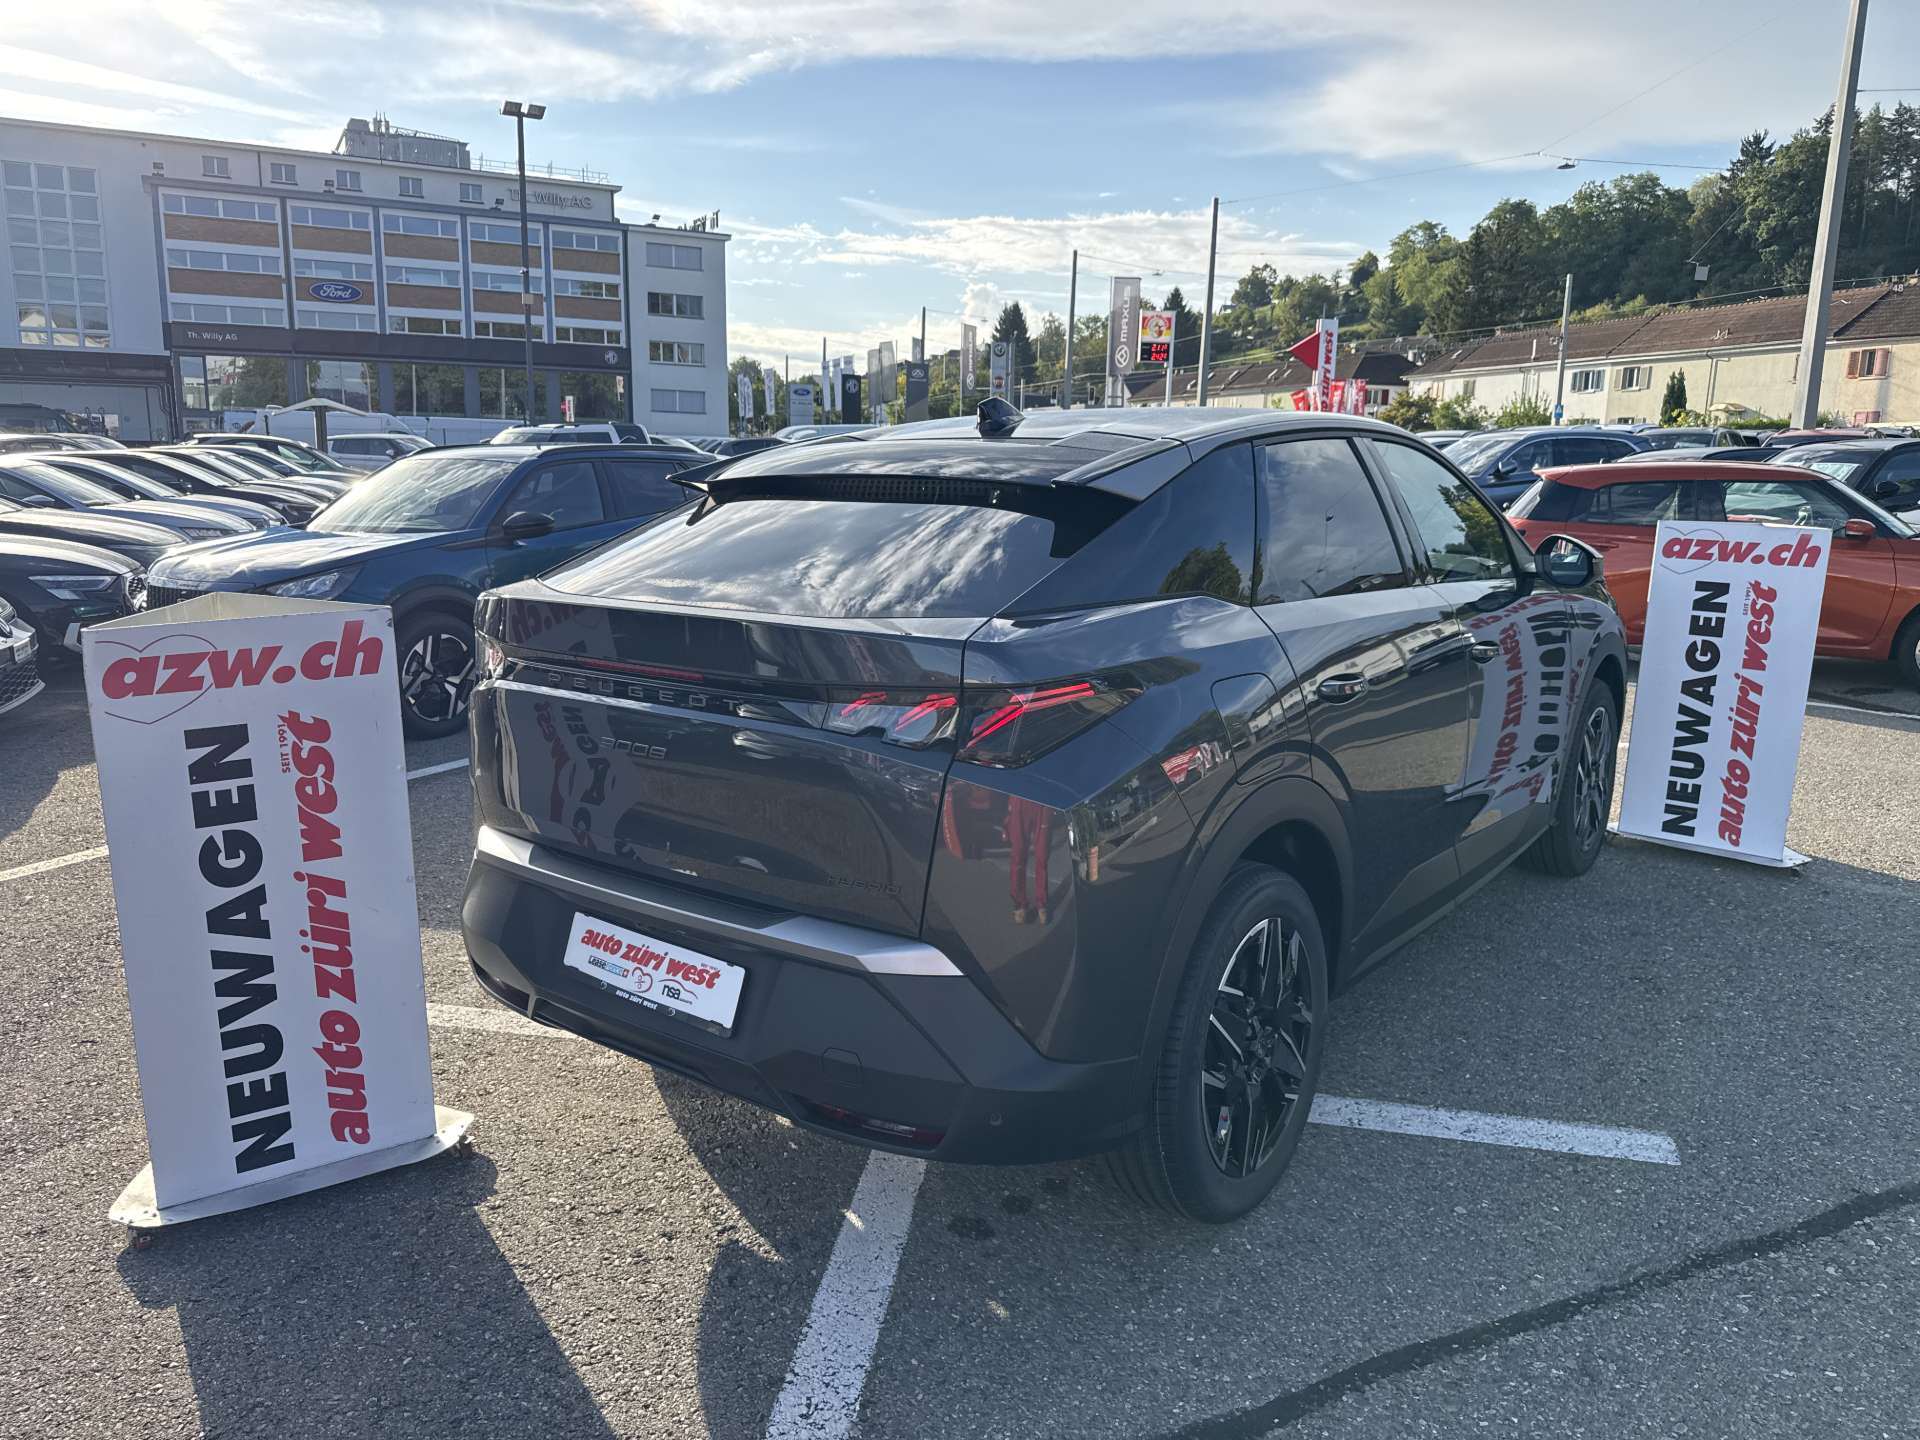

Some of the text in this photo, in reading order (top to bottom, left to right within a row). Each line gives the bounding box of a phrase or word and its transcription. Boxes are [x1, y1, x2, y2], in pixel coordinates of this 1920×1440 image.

[320, 284, 352, 298] Ford
[202, 331, 223, 341] Willy
[225, 333, 238, 341] AG
[1662, 533, 1823, 569] azw.ch
[101, 619, 384, 700] azw.ch
[549, 672, 739, 711] PEUGEOT
[1661, 580, 1730, 837] NEUWAGEN
[1718, 580, 1777, 847] auto züri west
[277, 723, 291, 774] SEIT 1991
[183, 722, 296, 1174] NEUWAGEN
[277, 709, 370, 1146] auto züri west
[581, 929, 623, 955] auto
[620, 943, 669, 971] züri
[666, 956, 721, 989] west
[661, 984, 681, 1000] nsa
